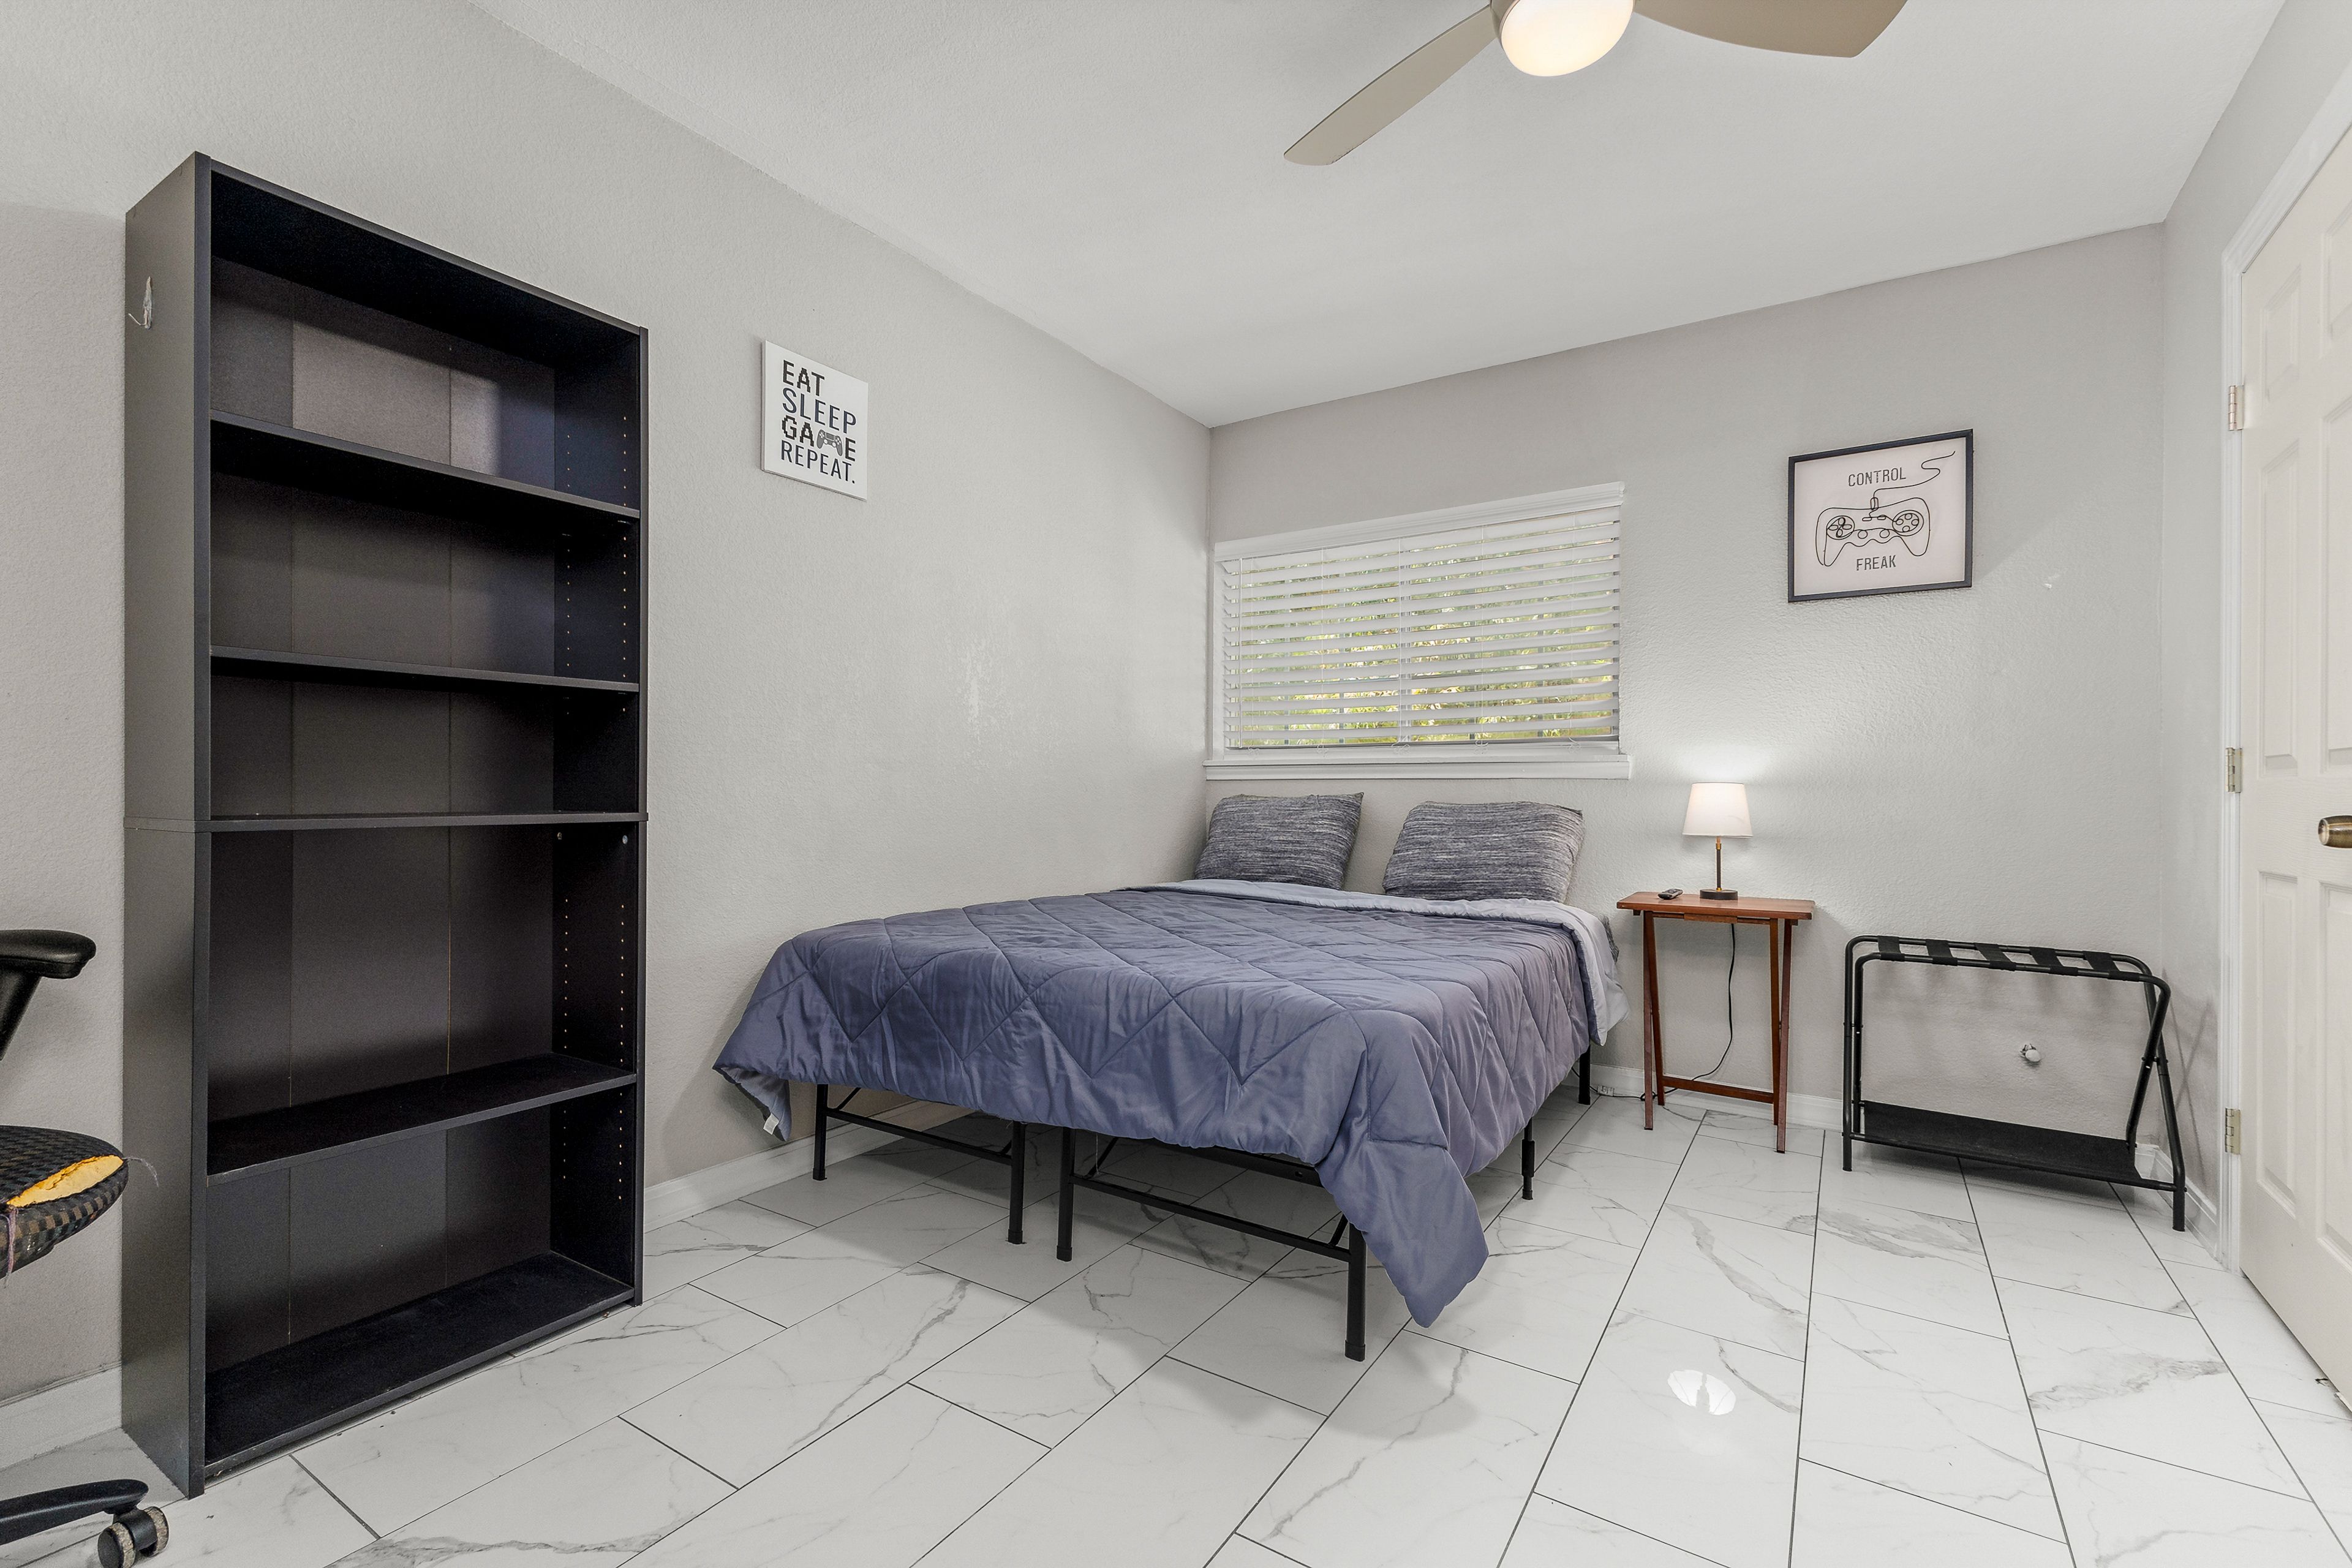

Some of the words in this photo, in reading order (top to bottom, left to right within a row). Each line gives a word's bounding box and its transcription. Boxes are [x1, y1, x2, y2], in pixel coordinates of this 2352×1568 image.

[783, 360, 825, 396] EAT
[782, 388, 856, 434] SLEEP
[782, 415, 856, 462] GAE
[781, 440, 855, 484] REPEAT.
[1848, 467, 1907, 486] CONTROL
[1856, 555, 1896, 571] FREAK
